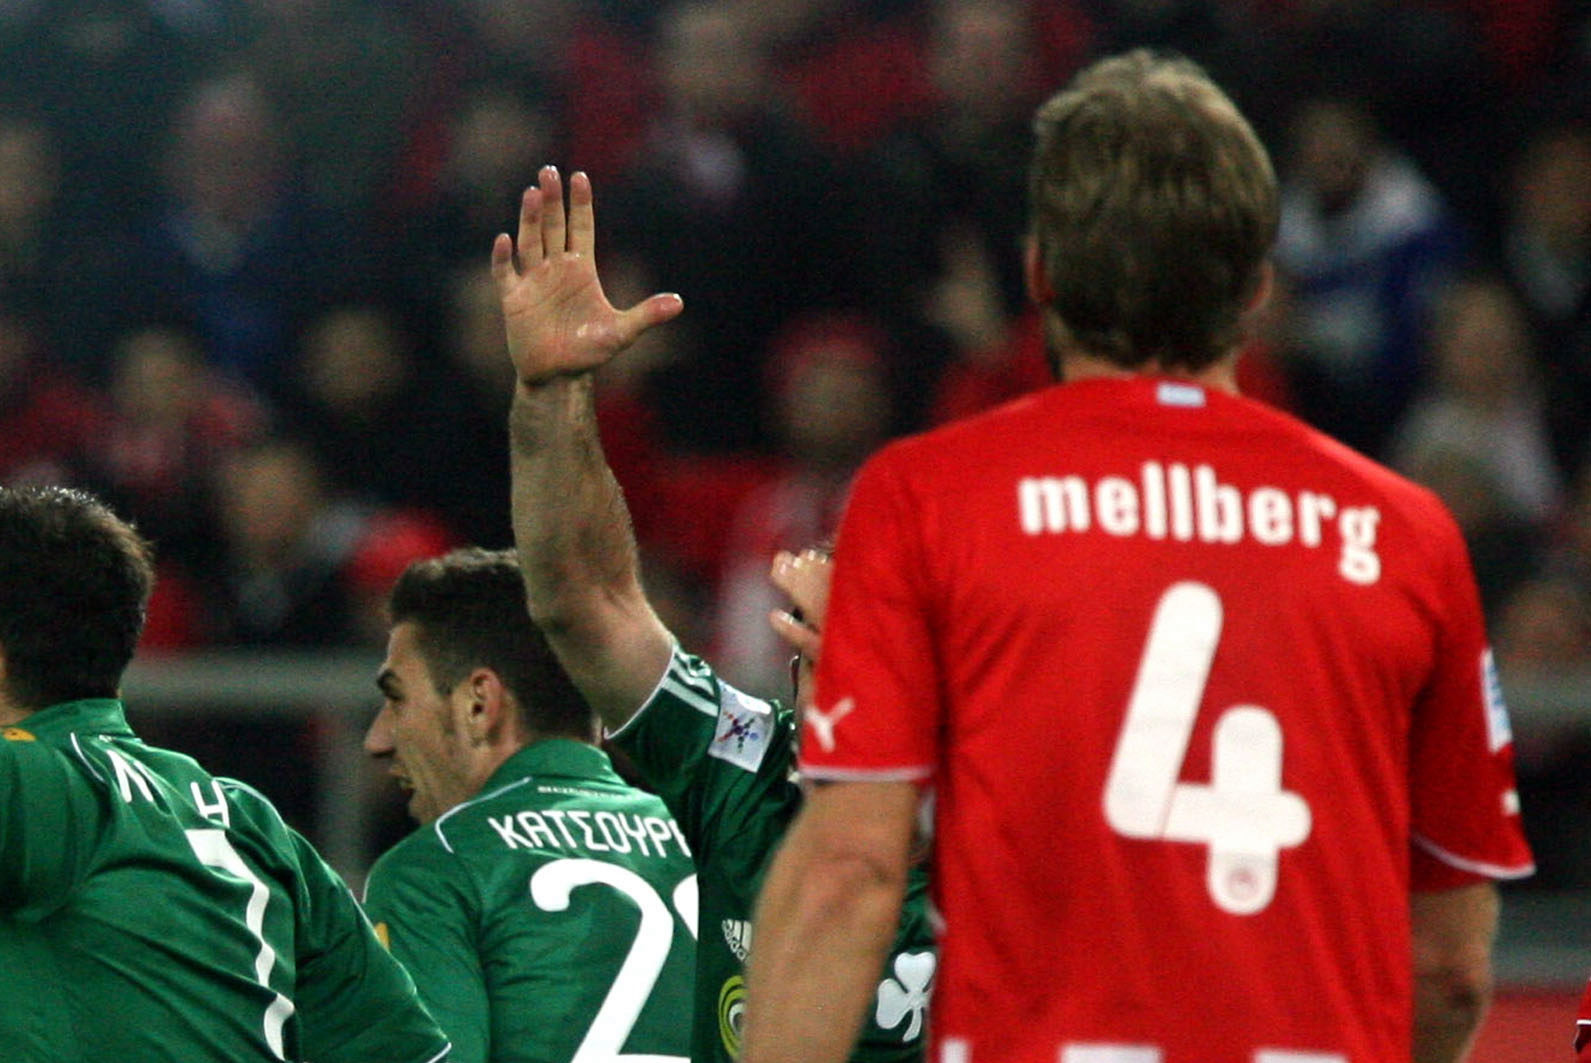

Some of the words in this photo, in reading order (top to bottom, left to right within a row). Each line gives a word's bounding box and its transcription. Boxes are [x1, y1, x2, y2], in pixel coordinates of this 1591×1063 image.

[1017, 461, 1381, 585] mellberg
[1103, 581, 1312, 916] 4
[184, 828, 296, 1062] 7
